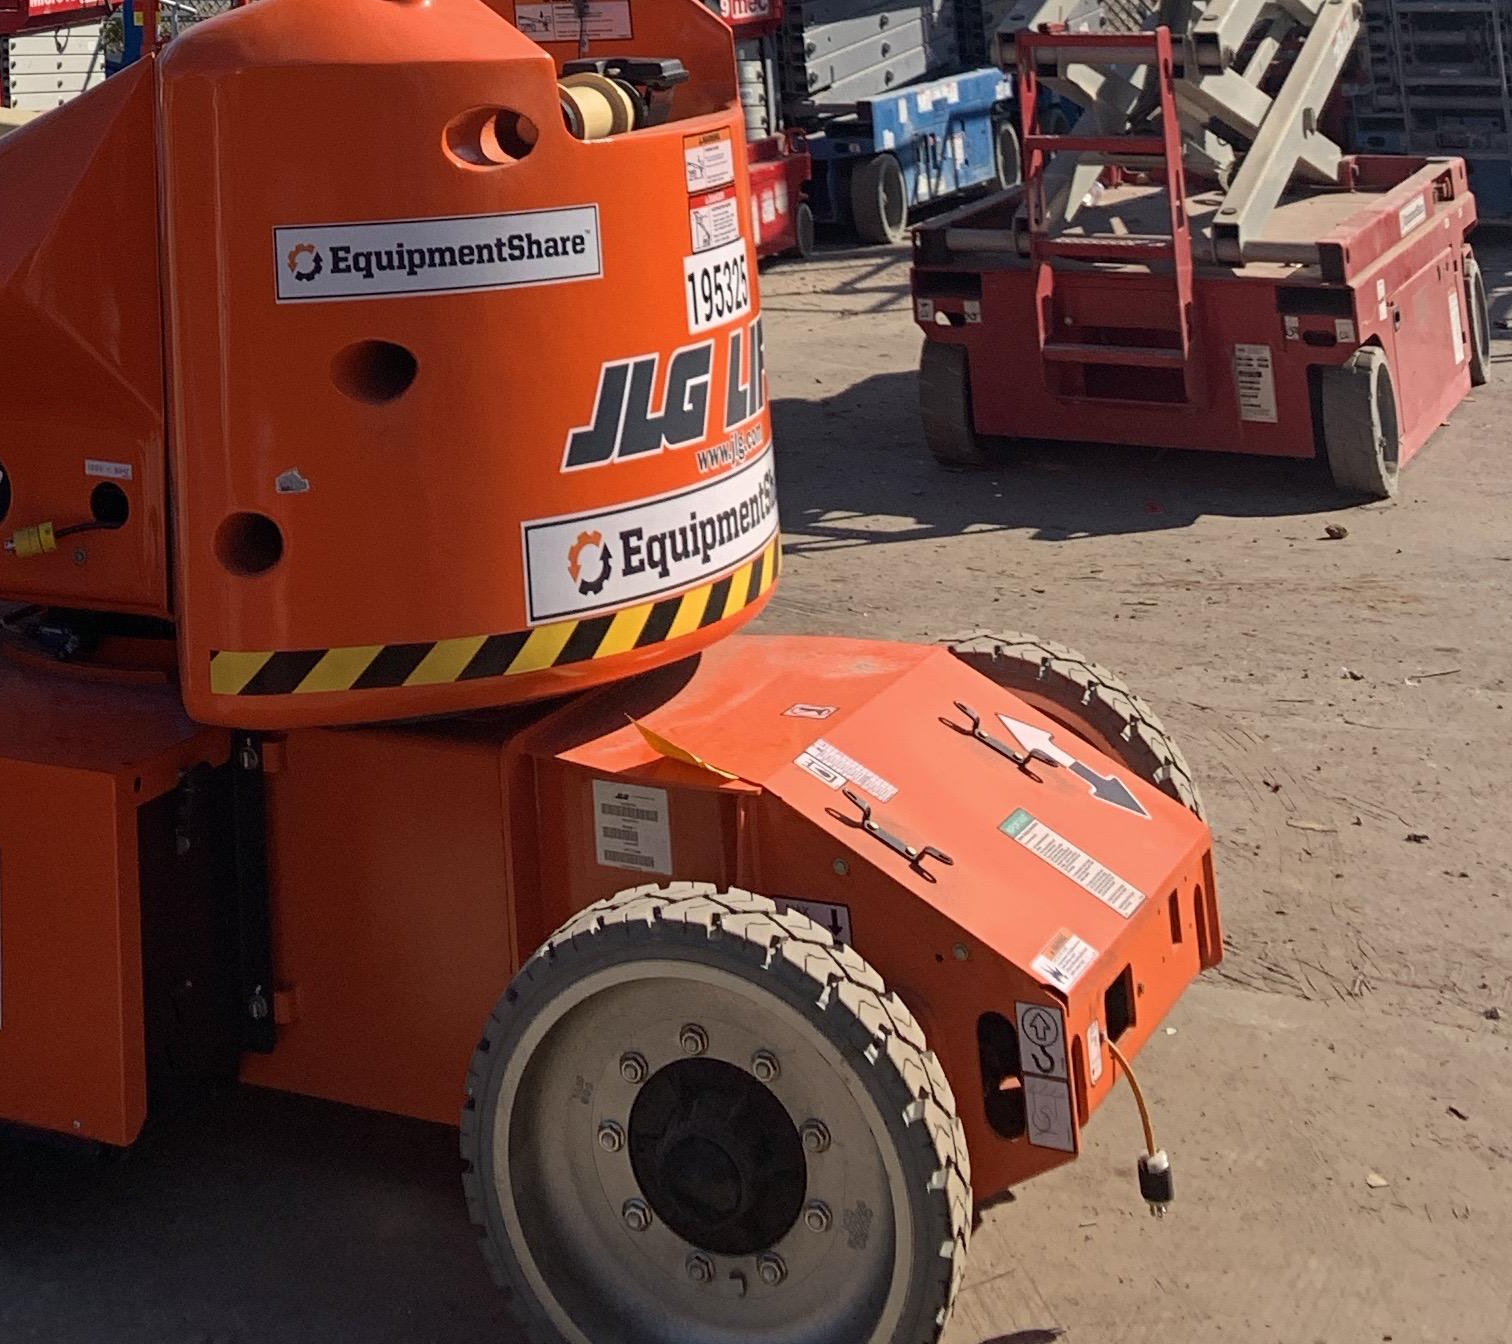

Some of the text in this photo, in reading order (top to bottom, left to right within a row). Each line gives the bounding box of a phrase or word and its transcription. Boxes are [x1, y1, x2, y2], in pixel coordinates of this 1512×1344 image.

[328, 231, 587, 280] EquipmentShare
[687, 255, 750, 327] 195325
[561, 339, 715, 473] JLG
[696, 424, 765, 473] www.jlg.com
